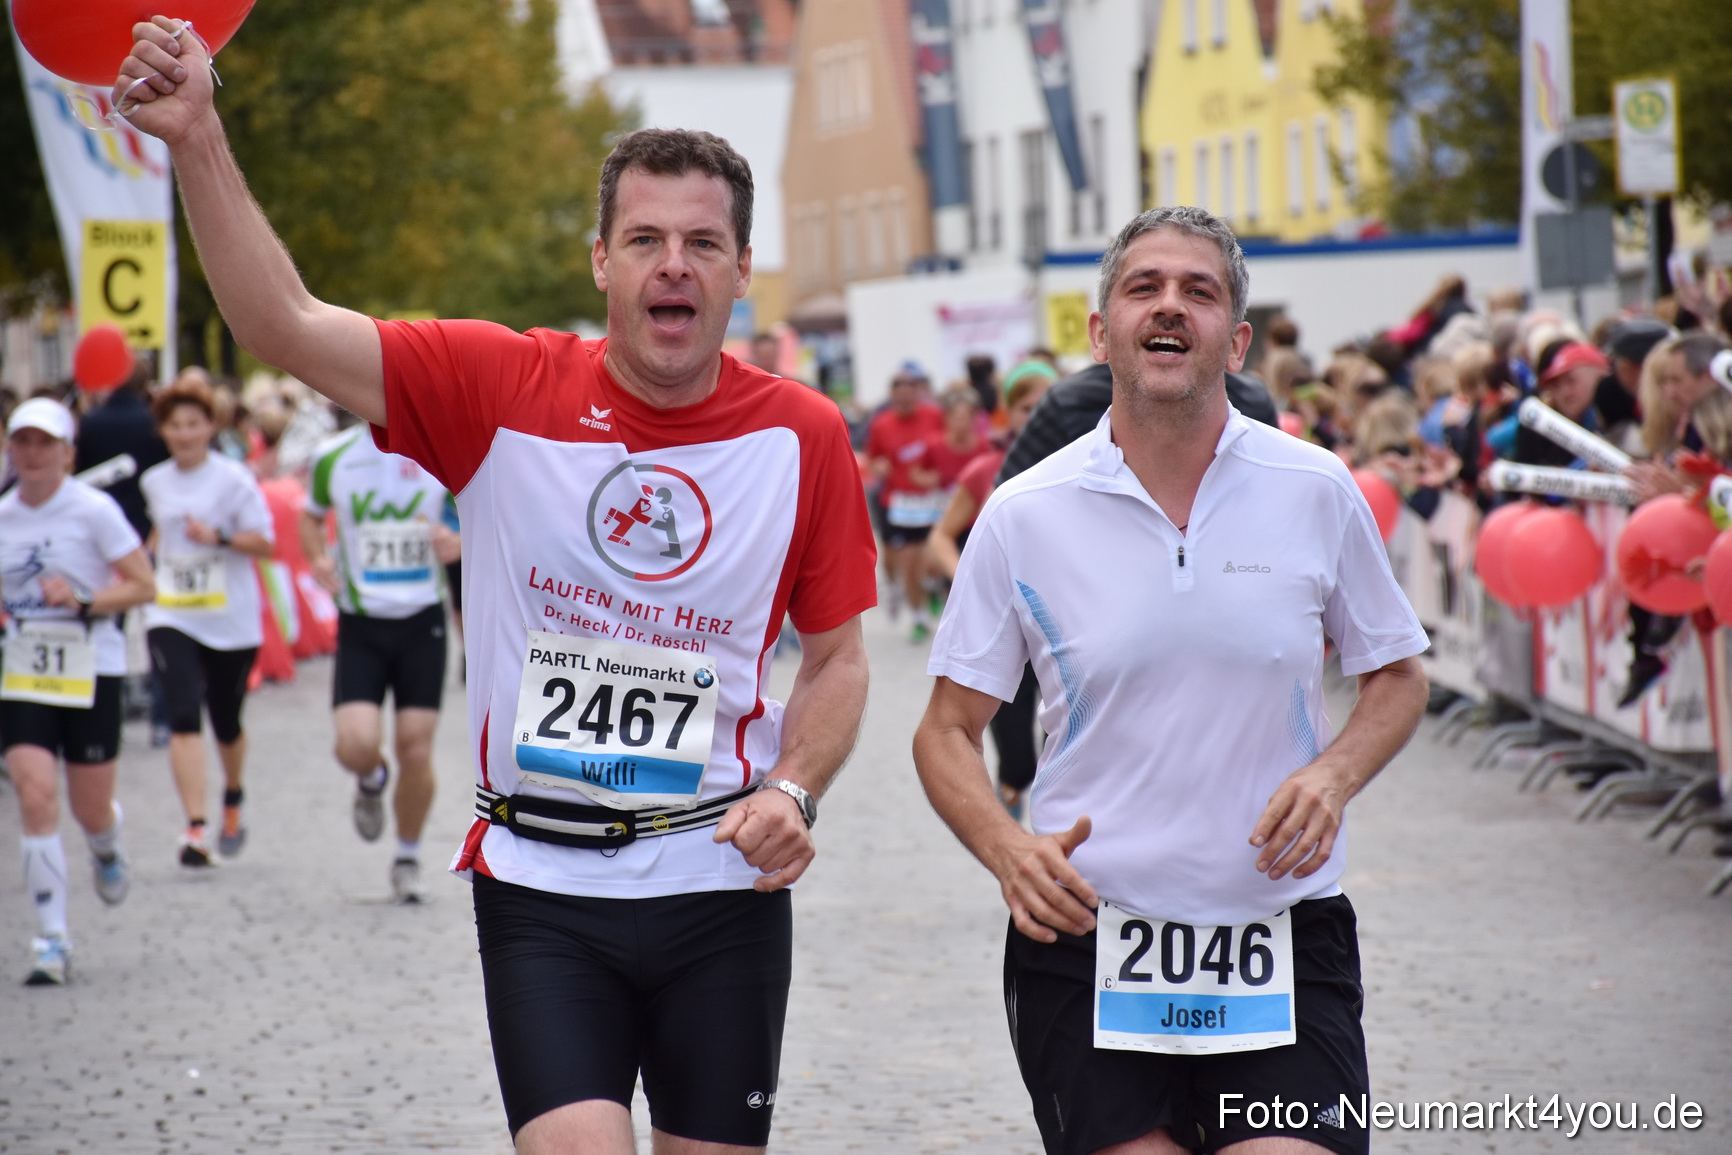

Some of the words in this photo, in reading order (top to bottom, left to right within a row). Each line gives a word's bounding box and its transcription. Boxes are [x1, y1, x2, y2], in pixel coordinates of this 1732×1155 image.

[91, 223, 156, 248] Block
[103, 257, 142, 316] C
[579, 416, 612, 432] erima
[1237, 564, 1271, 574] odlo
[544, 604, 566, 622] Dr.
[570, 613, 610, 635] Heck
[612, 622, 622, 639] /
[625, 626, 647, 643] Dr.
[651, 634, 706, 653] Röschl
[32, 644, 66, 673] 31
[529, 648, 591, 671] PARTL
[596, 657, 686, 684] Neumarkt
[536, 677, 700, 751] 2467
[521, 732, 530, 743] B
[580, 760, 637, 786] Willi
[1118, 919, 1275, 987] 2046
[1104, 977, 1112, 989] C
[1160, 1002, 1227, 1030] Josef
